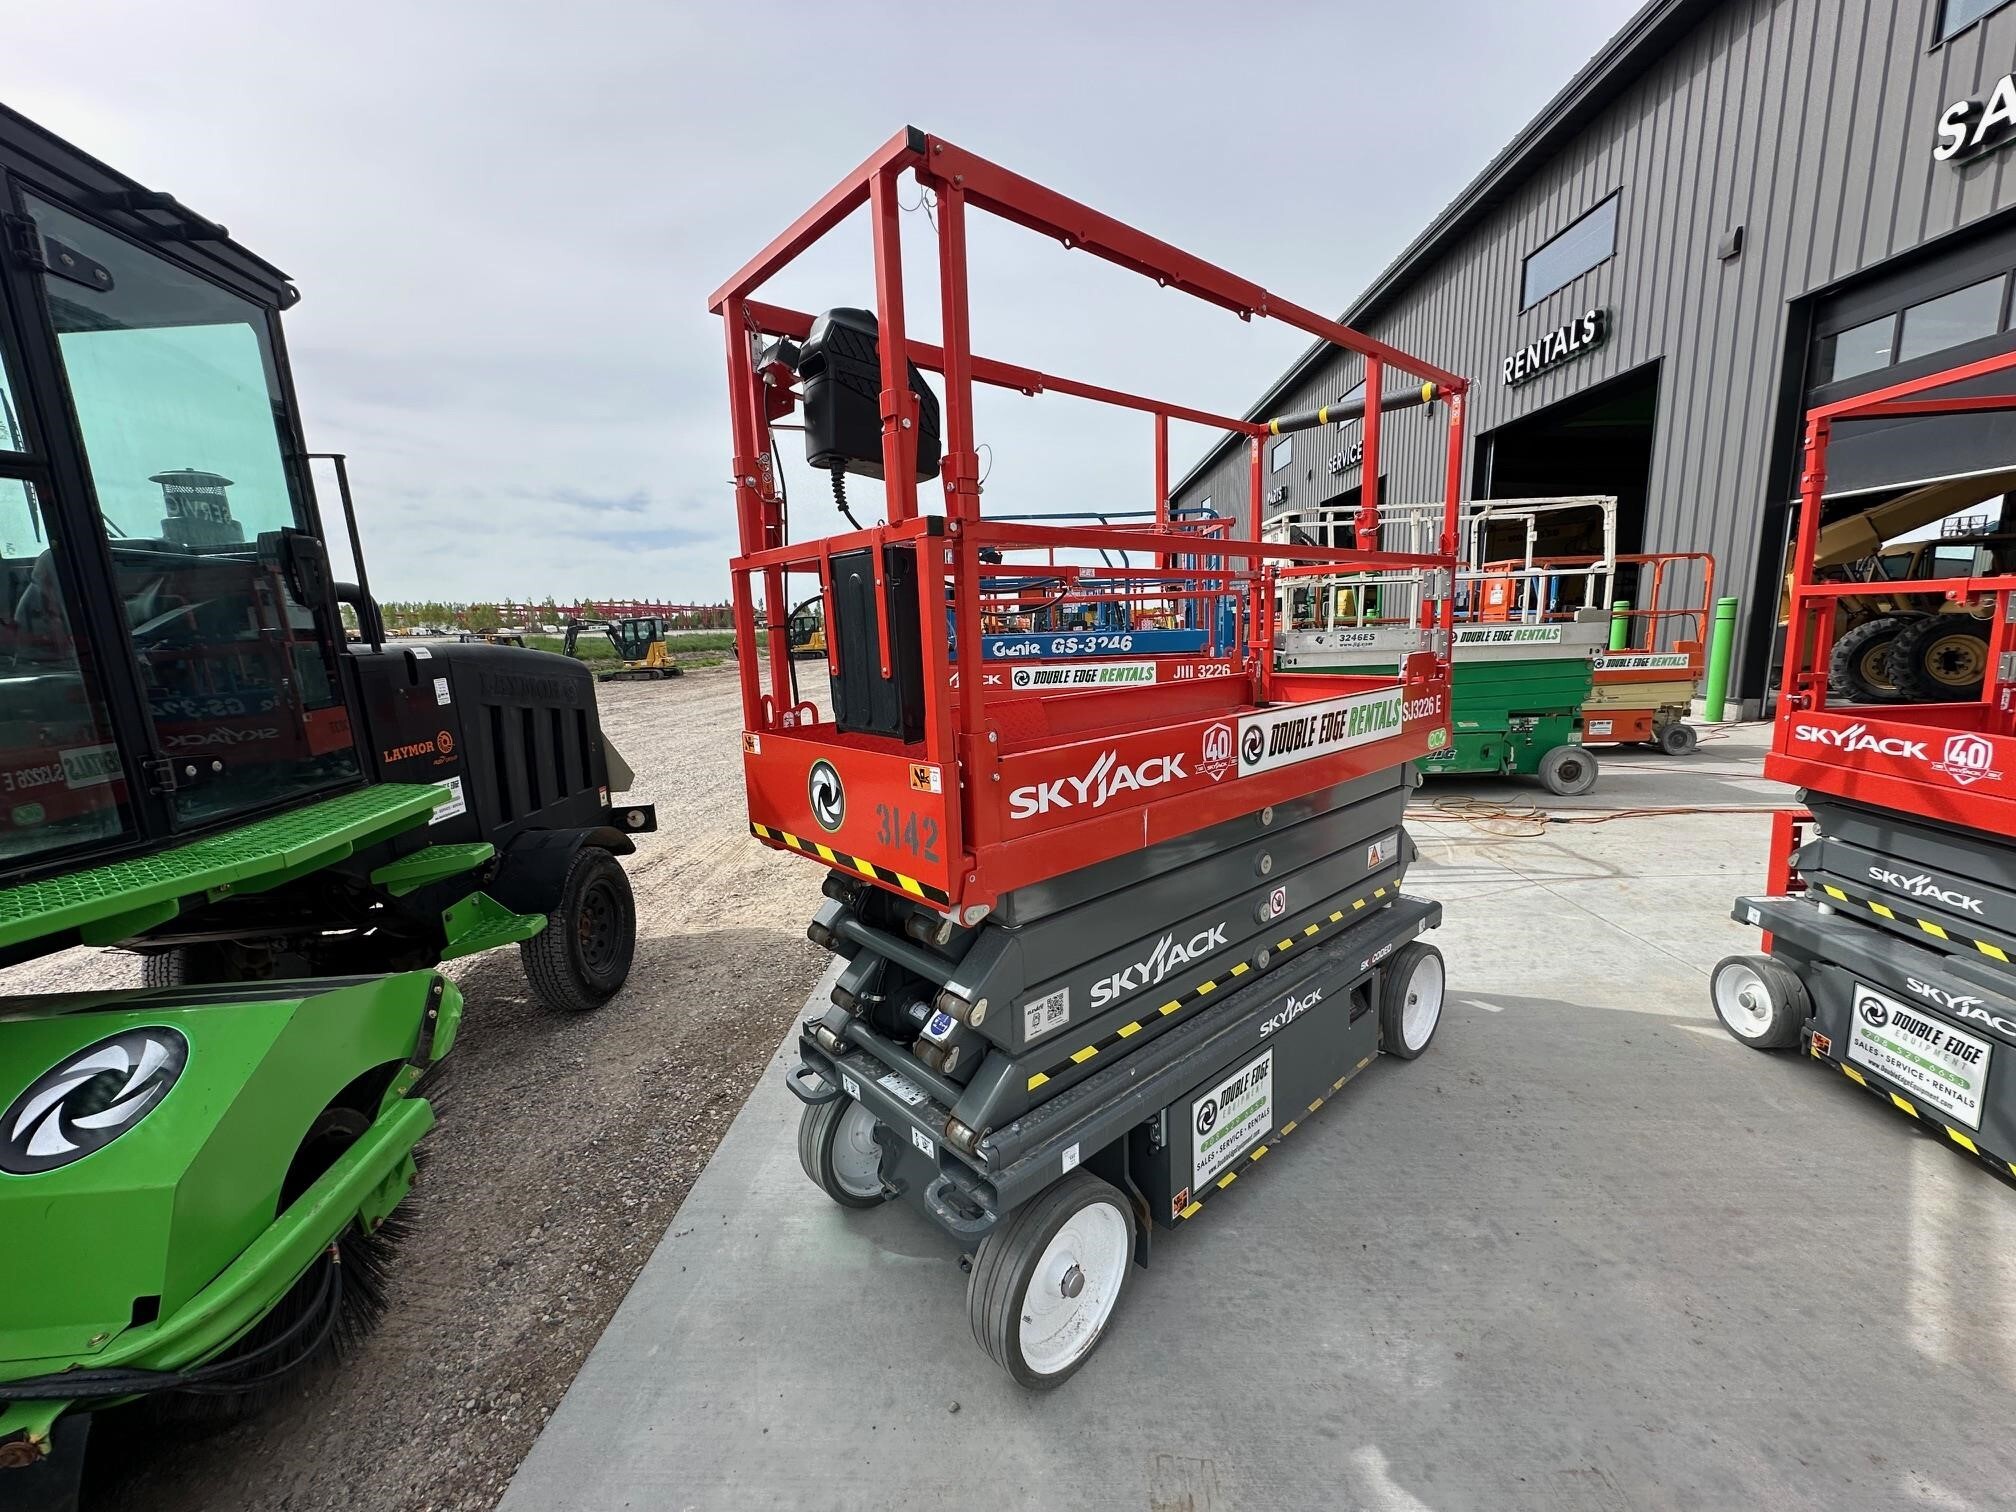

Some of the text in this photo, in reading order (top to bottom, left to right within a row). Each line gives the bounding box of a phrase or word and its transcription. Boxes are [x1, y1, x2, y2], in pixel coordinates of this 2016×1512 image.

[1502, 309, 1597, 386] RENTALS
[1328, 440, 1363, 474] SERVICE
[993, 636, 1133, 657] Genie GS-3246
[1339, 633, 1376, 642] 3246ES
[1460, 628, 1560, 643] DOUBLE EDGE RENTALS
[1033, 669, 1071, 685] DOUBLE
[1072, 669, 1098, 683] EDGE
[1099, 666, 1154, 683] RENTALS
[1198, 664, 1231, 678] 3226
[1649, 656, 1688, 667] RENTALS
[1268, 694, 1442, 758] DOUBLE EDGE RENTALS SJ3226 E
[1795, 723, 1987, 768] SKYJACK 40
[383, 741, 435, 763] LAYMOR
[1009, 730, 1229, 819] SKYJACK 40
[876, 804, 940, 864] 3142
[1868, 867, 1984, 915] SKYJACK
[1090, 921, 1228, 1008] SKYJACK
[1259, 988, 1324, 1038] SKYJACK
[1866, 1031, 1964, 1087] 208 529 6653
[1892, 1011, 1984, 1066] DOUBLE EDGE
[1895, 1029, 1968, 1071] EQUIPMENT
[1219, 1057, 1270, 1111] DOUBLE EDGE
[1854, 1038, 1976, 1109] SALES SERVICE RENTALS
[1196, 1107, 1270, 1171] SALES SERVICE RENTALS
